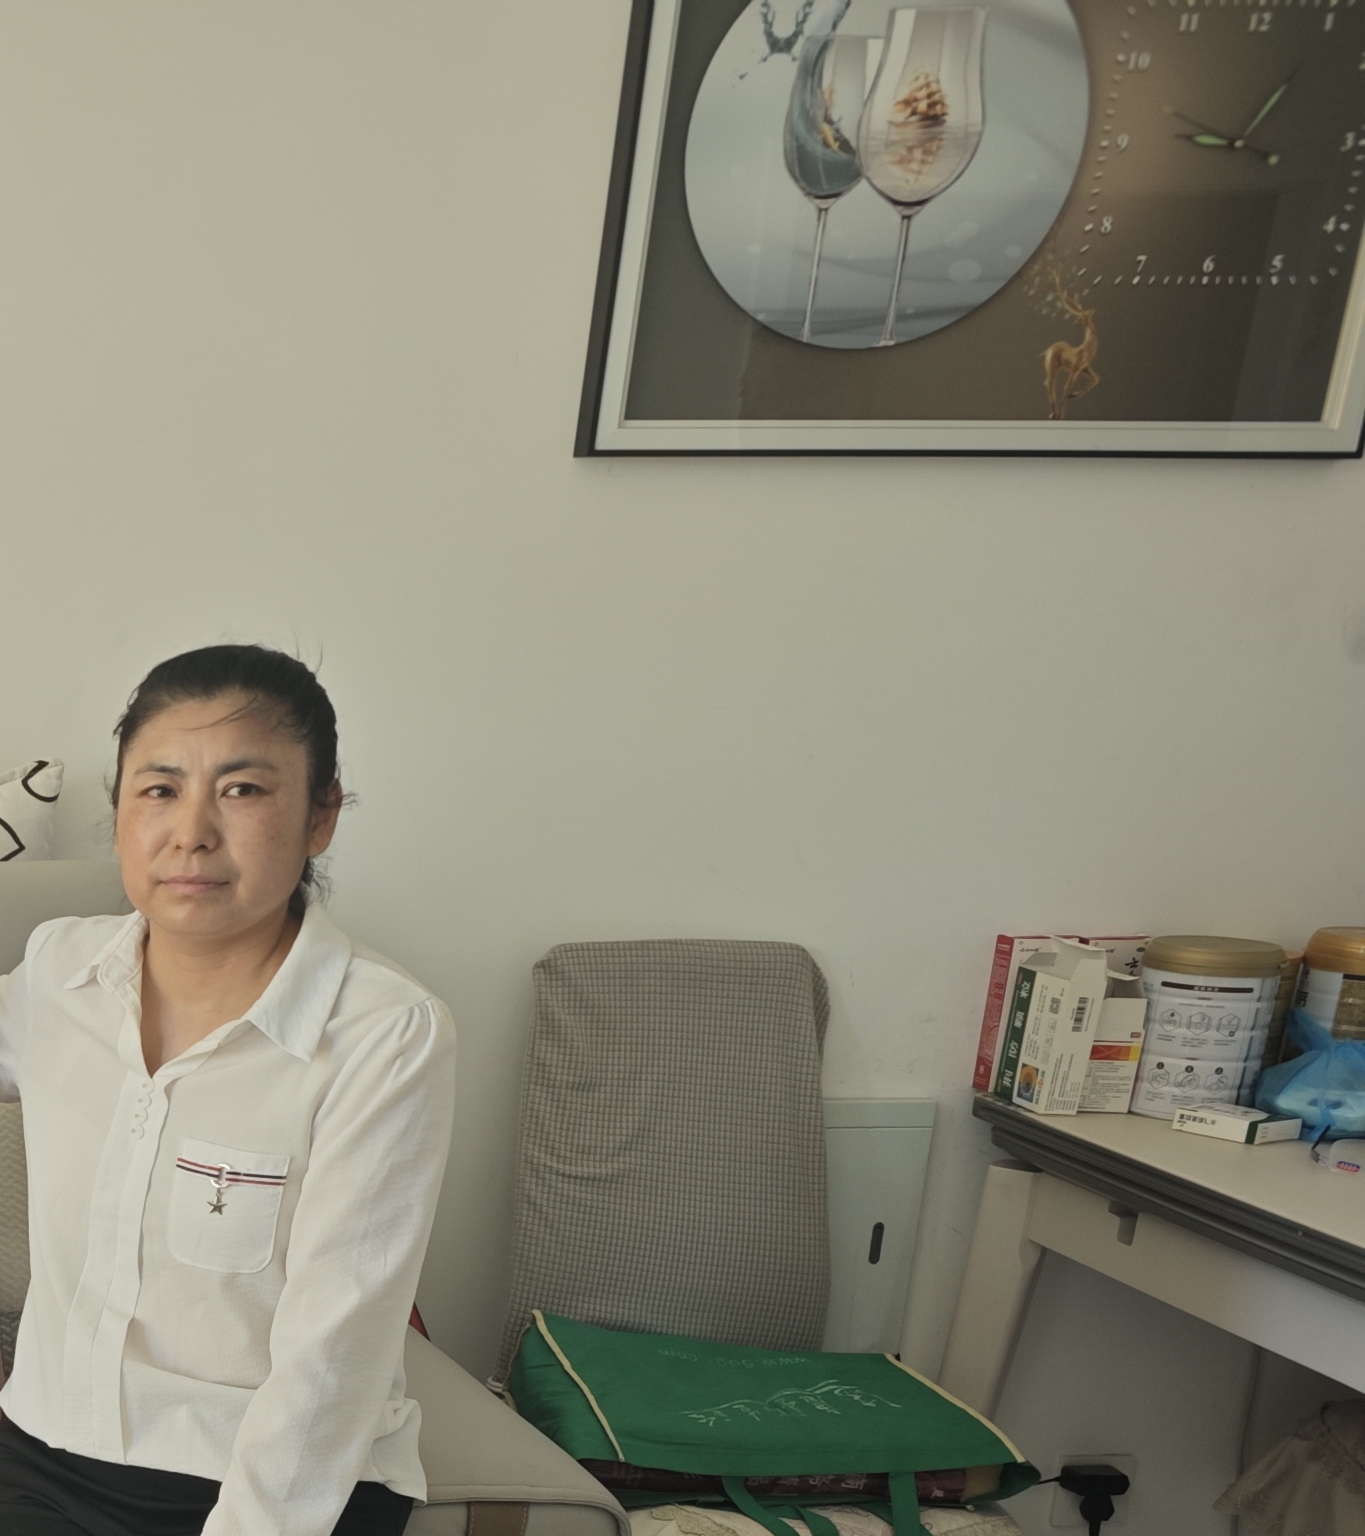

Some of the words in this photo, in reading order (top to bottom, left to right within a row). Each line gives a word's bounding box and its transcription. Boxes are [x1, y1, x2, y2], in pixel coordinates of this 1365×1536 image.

[1179, 12, 1200, 32] 11
[1249, 12, 1273, 32] 12
[1324, 12, 1335, 32] 1
[1128, 52, 1151, 70] 10
[1117, 133, 1129, 150] 9
[1340, 131, 1356, 151] 3
[1100, 216, 1113, 234] 8
[1323, 215, 1337, 233] 4
[1136, 255, 1148, 272] 7
[1202, 255, 1216, 273] 6
[1270, 254, 1284, 273] 5
